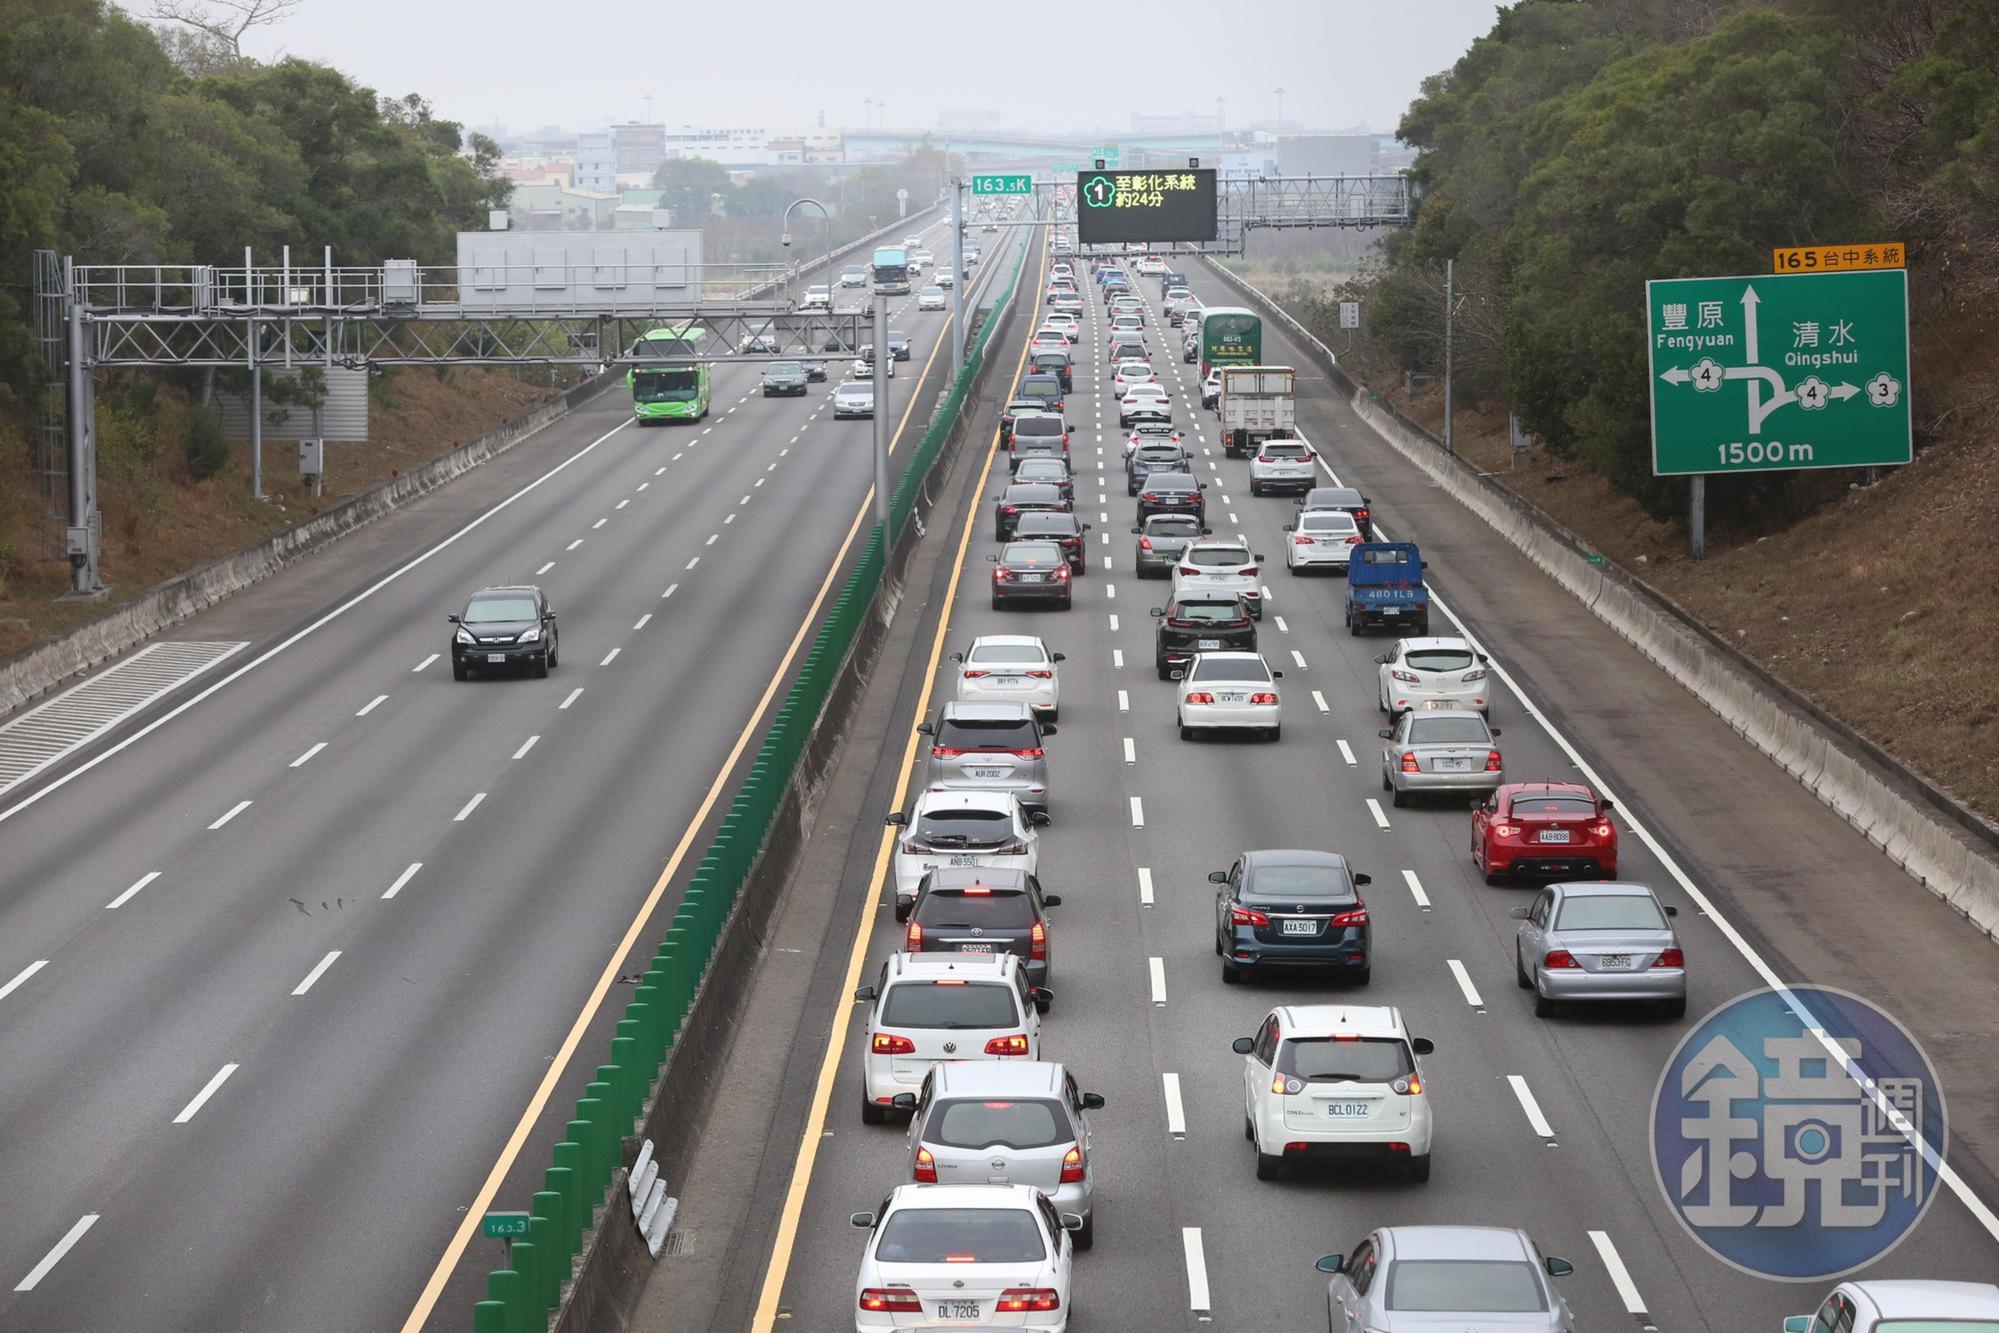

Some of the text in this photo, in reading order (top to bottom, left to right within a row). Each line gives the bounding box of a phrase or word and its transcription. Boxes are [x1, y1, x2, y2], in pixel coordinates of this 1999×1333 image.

[975, 177, 1028, 192] 163.5K
[1115, 174, 1196, 191] 至彰化系統
[1095, 184, 1103, 200] 1
[1115, 192, 1164, 208] 約24分
[1778, 247, 1900, 269] 165 台中系統
[1661, 301, 1724, 331] 豐原
[1792, 319, 1855, 348] 清水
[1657, 333, 1734, 351] Fengyuan
[1784, 349, 1859, 368] Qingshui
[1700, 368, 1711, 382] 4
[1806, 386, 1817, 400] 4
[1878, 382, 1889, 397] 3
[1718, 441, 1784, 464] 1500
[491, 1220, 526, 1233] 163.3
